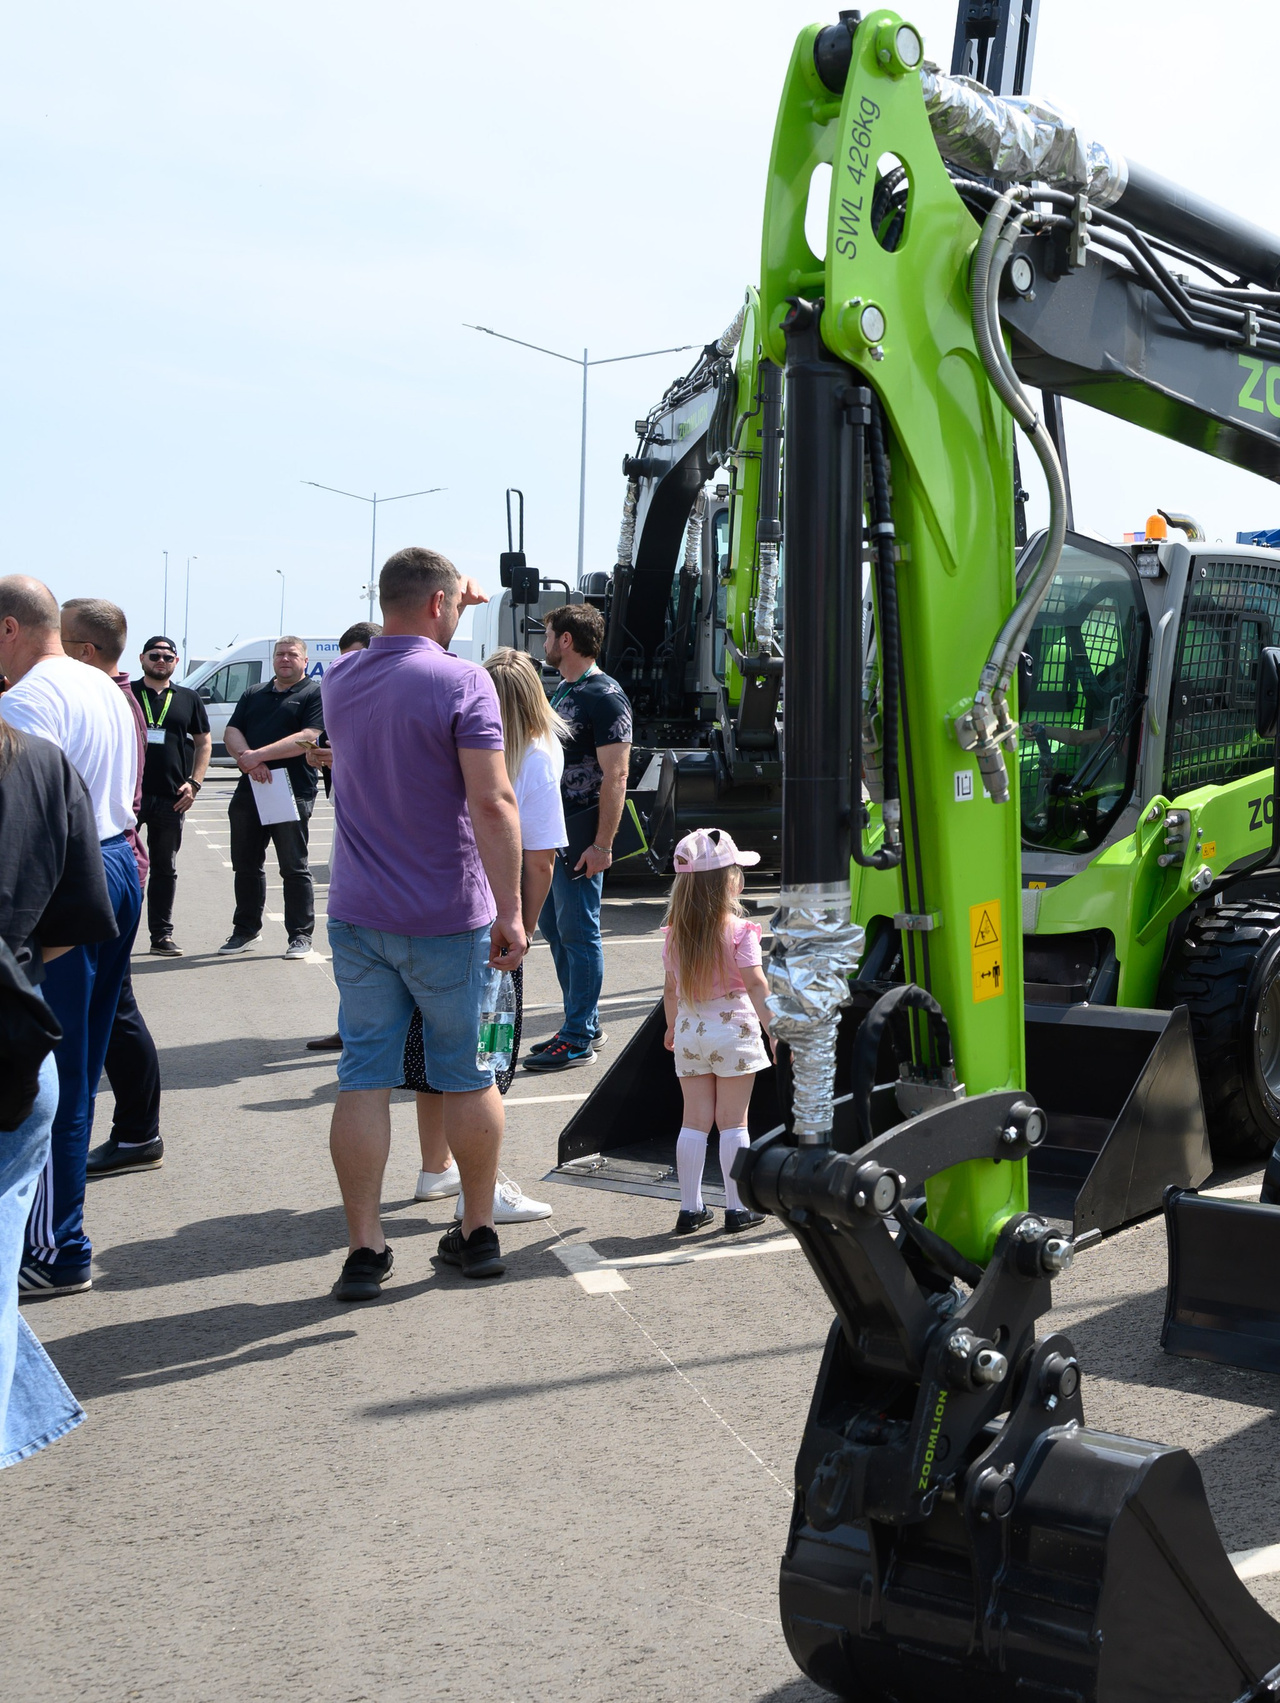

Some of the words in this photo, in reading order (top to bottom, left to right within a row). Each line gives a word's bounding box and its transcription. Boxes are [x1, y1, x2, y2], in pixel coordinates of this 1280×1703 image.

[846, 95, 881, 186] 426kg
[835, 196, 864, 260] SWL
[918, 1389, 948, 1490] ZOOMLION
